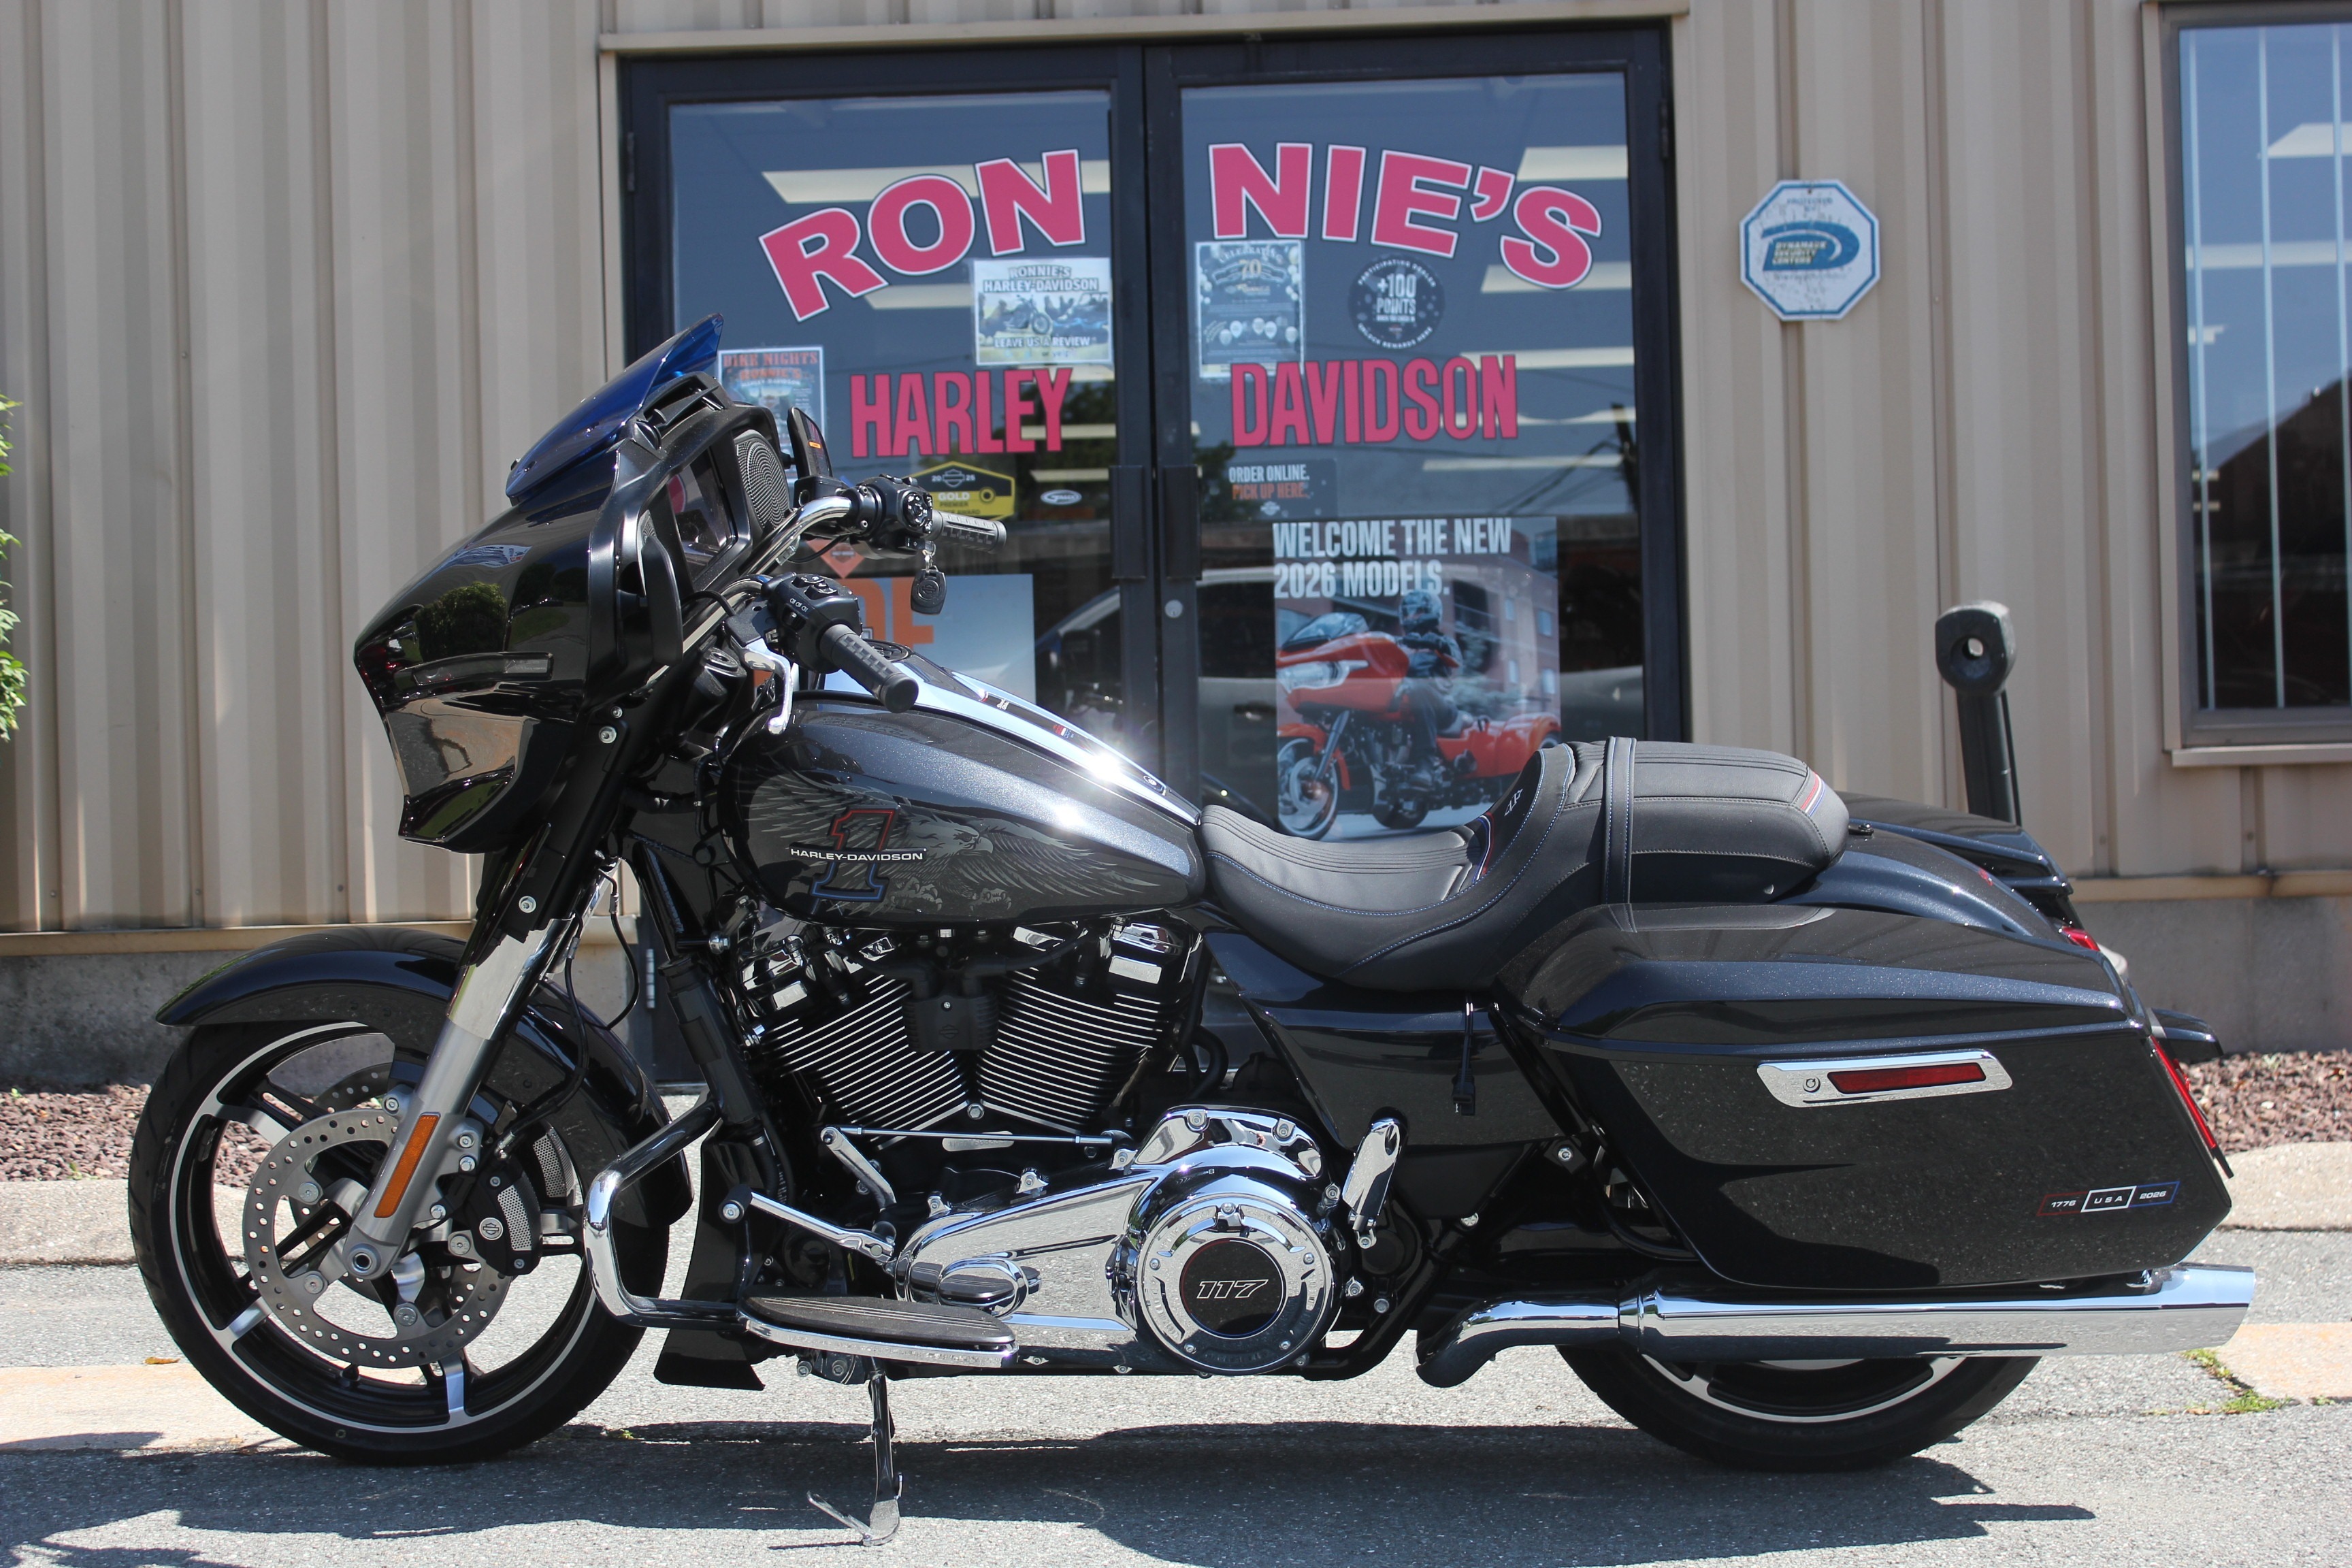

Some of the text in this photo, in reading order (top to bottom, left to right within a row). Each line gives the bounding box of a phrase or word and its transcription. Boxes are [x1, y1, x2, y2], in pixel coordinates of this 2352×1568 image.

[759, 149, 1085, 323] RON
[1009, 265, 1072, 278] RONNIE'S
[1239, 259, 1261, 280] 70
[983, 278, 1099, 292] HARLEY-DAVIDSON
[1377, 274, 1417, 298] +100
[1376, 297, 1416, 315] POINTS
[994, 336, 1090, 348] LEAVE US A REVIEW
[763, 352, 818, 365] NIGHTS
[1230, 354, 1518, 447] DAVIDSON
[850, 368, 1073, 458] HARLEY
[1228, 464, 1309, 483] ORDER ONLINE.
[938, 491, 970, 501] GOLD
[1232, 480, 1309, 500] PICK UP HERE.
[1273, 517, 1512, 557] WELCOME THE NEW
[1274, 559, 1450, 599] 2026 MODELS.
[791, 848, 923, 862] HARLEY-DAVIDSON
[2051, 1200, 2077, 1208] 1776
[2139, 1190, 2167, 1200] 2026
[1196, 1279, 1269, 1299] 117
